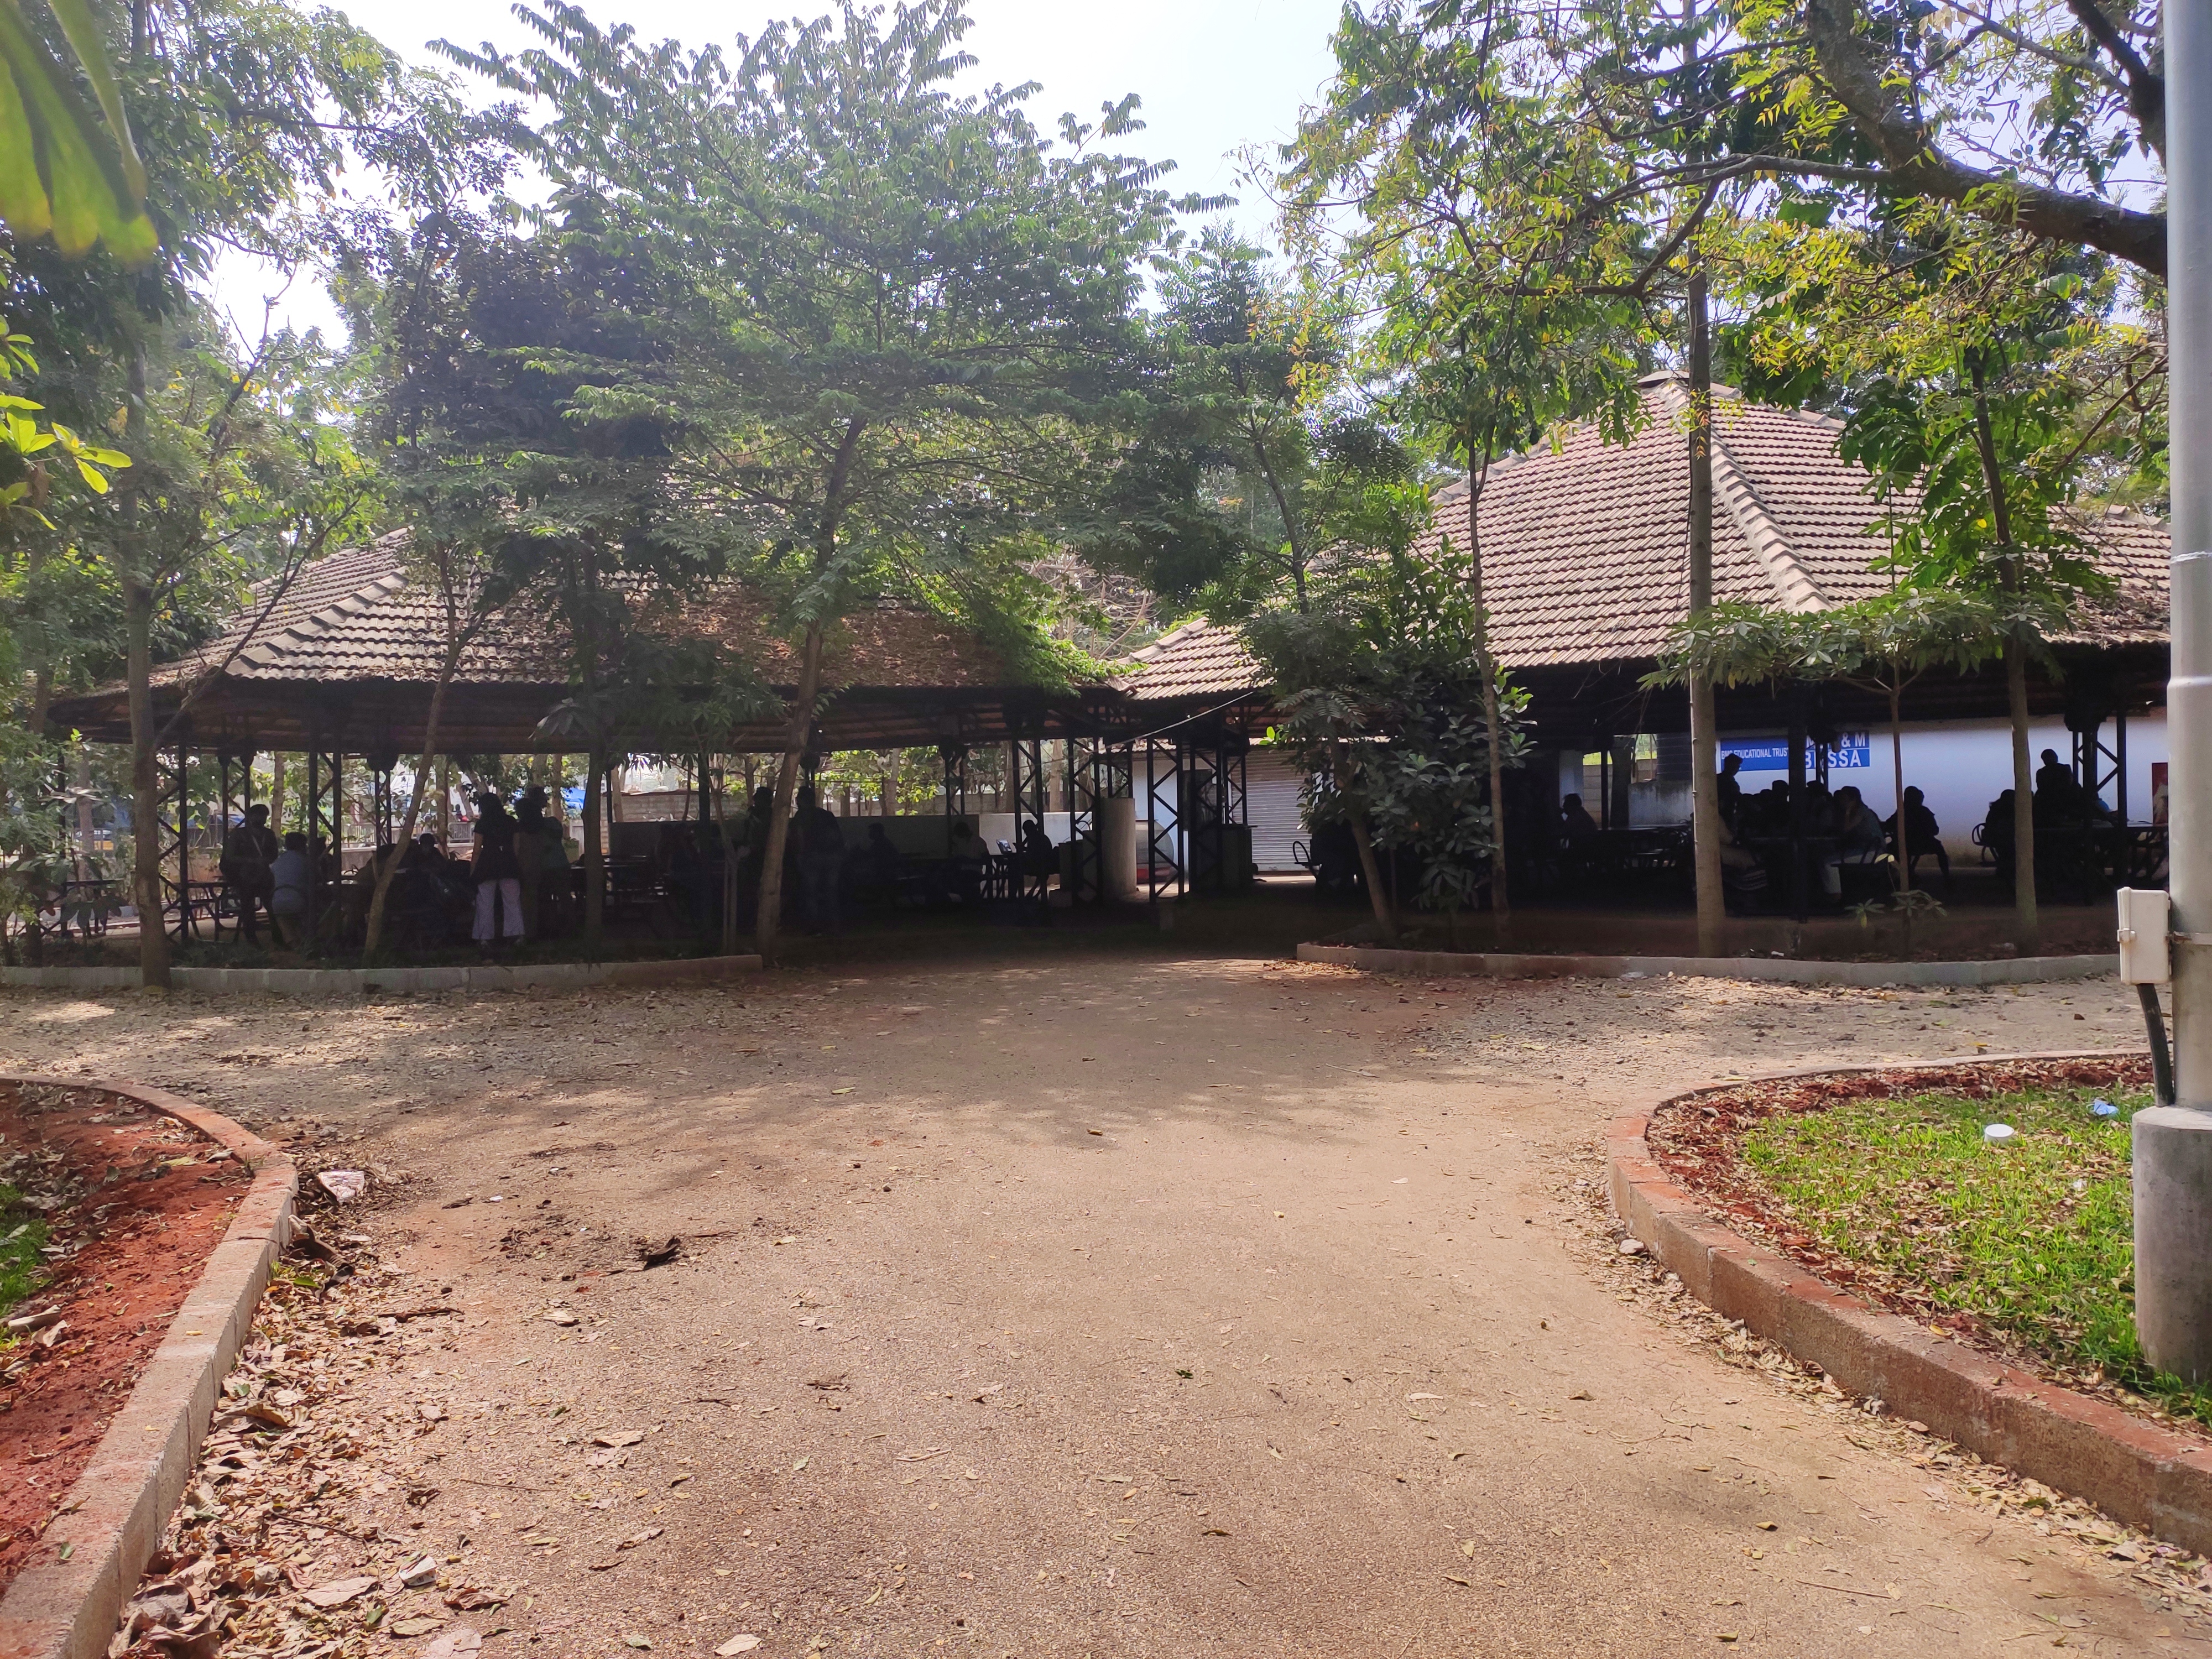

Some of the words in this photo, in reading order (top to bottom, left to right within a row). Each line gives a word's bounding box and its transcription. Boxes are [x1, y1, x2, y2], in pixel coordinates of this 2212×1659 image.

[1841, 732, 1851, 748] &
[1855, 732, 1865, 747] M
[1805, 749, 1862, 769] BSSA
